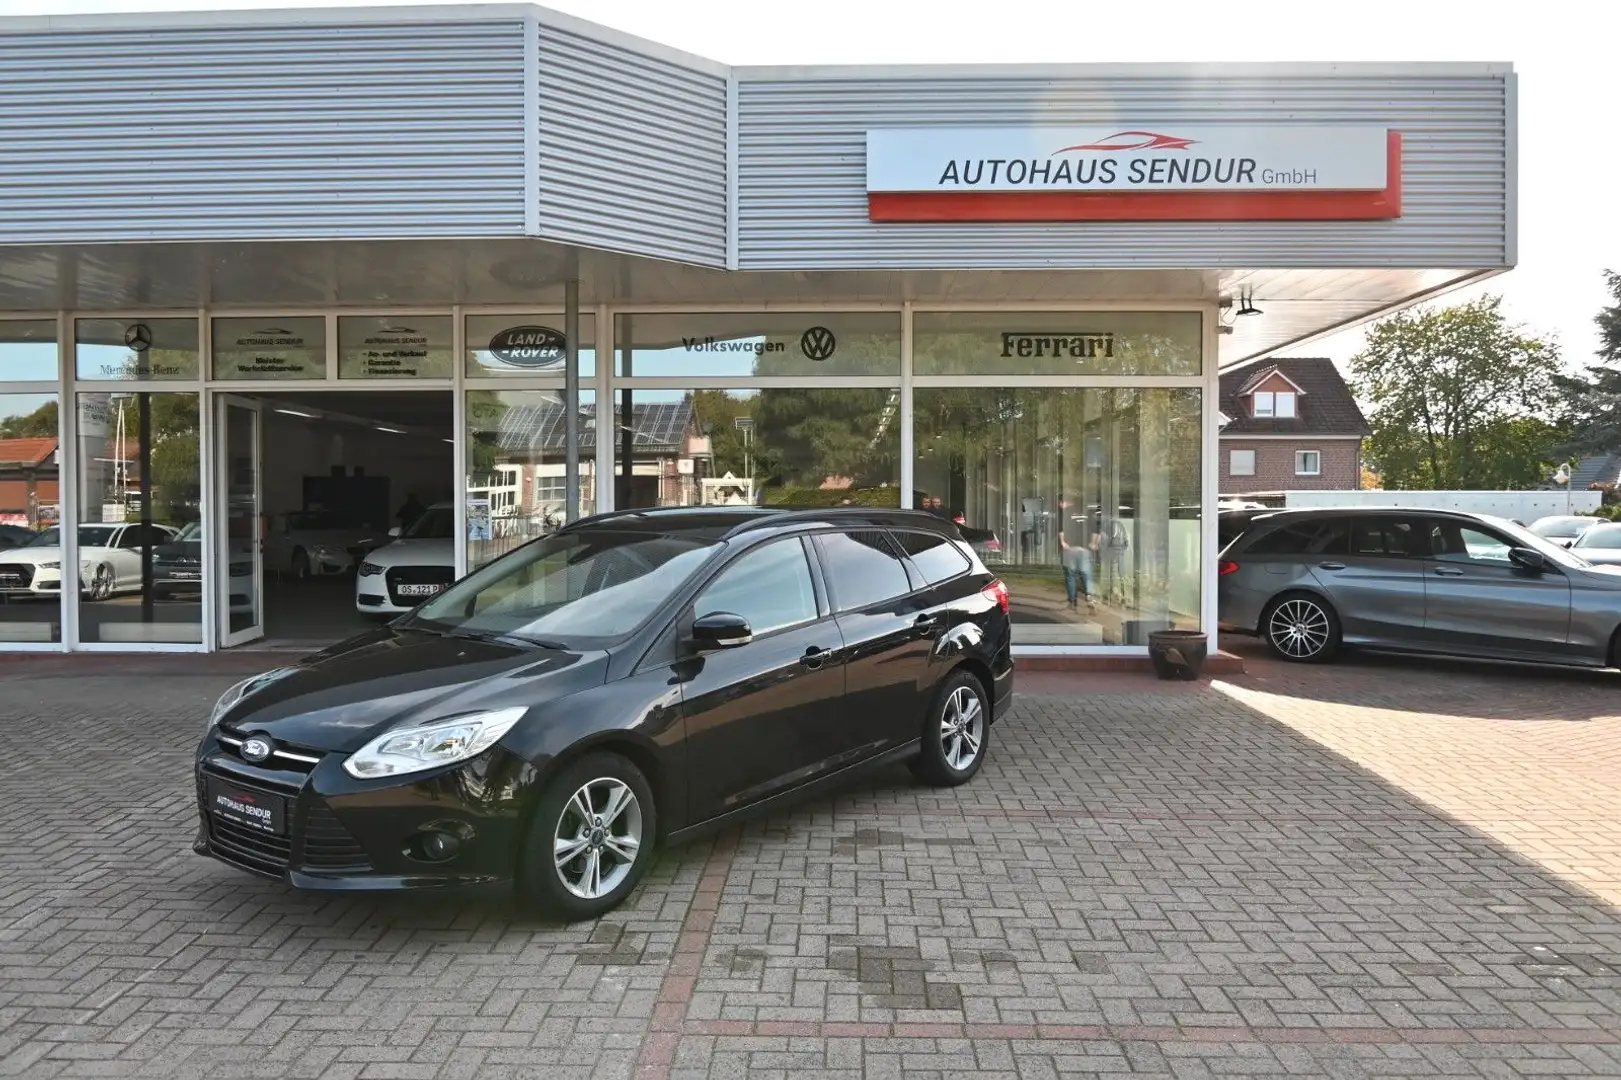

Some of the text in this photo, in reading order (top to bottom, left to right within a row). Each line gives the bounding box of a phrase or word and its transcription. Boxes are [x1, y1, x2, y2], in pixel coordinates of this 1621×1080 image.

[939, 158, 1317, 185] AUTOHAUS SENDUR GmbH
[682, 336, 785, 356] Volkswagen
[1000, 332, 1113, 358] Ferrari
[100, 364, 180, 375] Mercedes-Benz
[217, 795, 245, 812] AUTOHAUS
[245, 804, 271, 819] SENDUR
